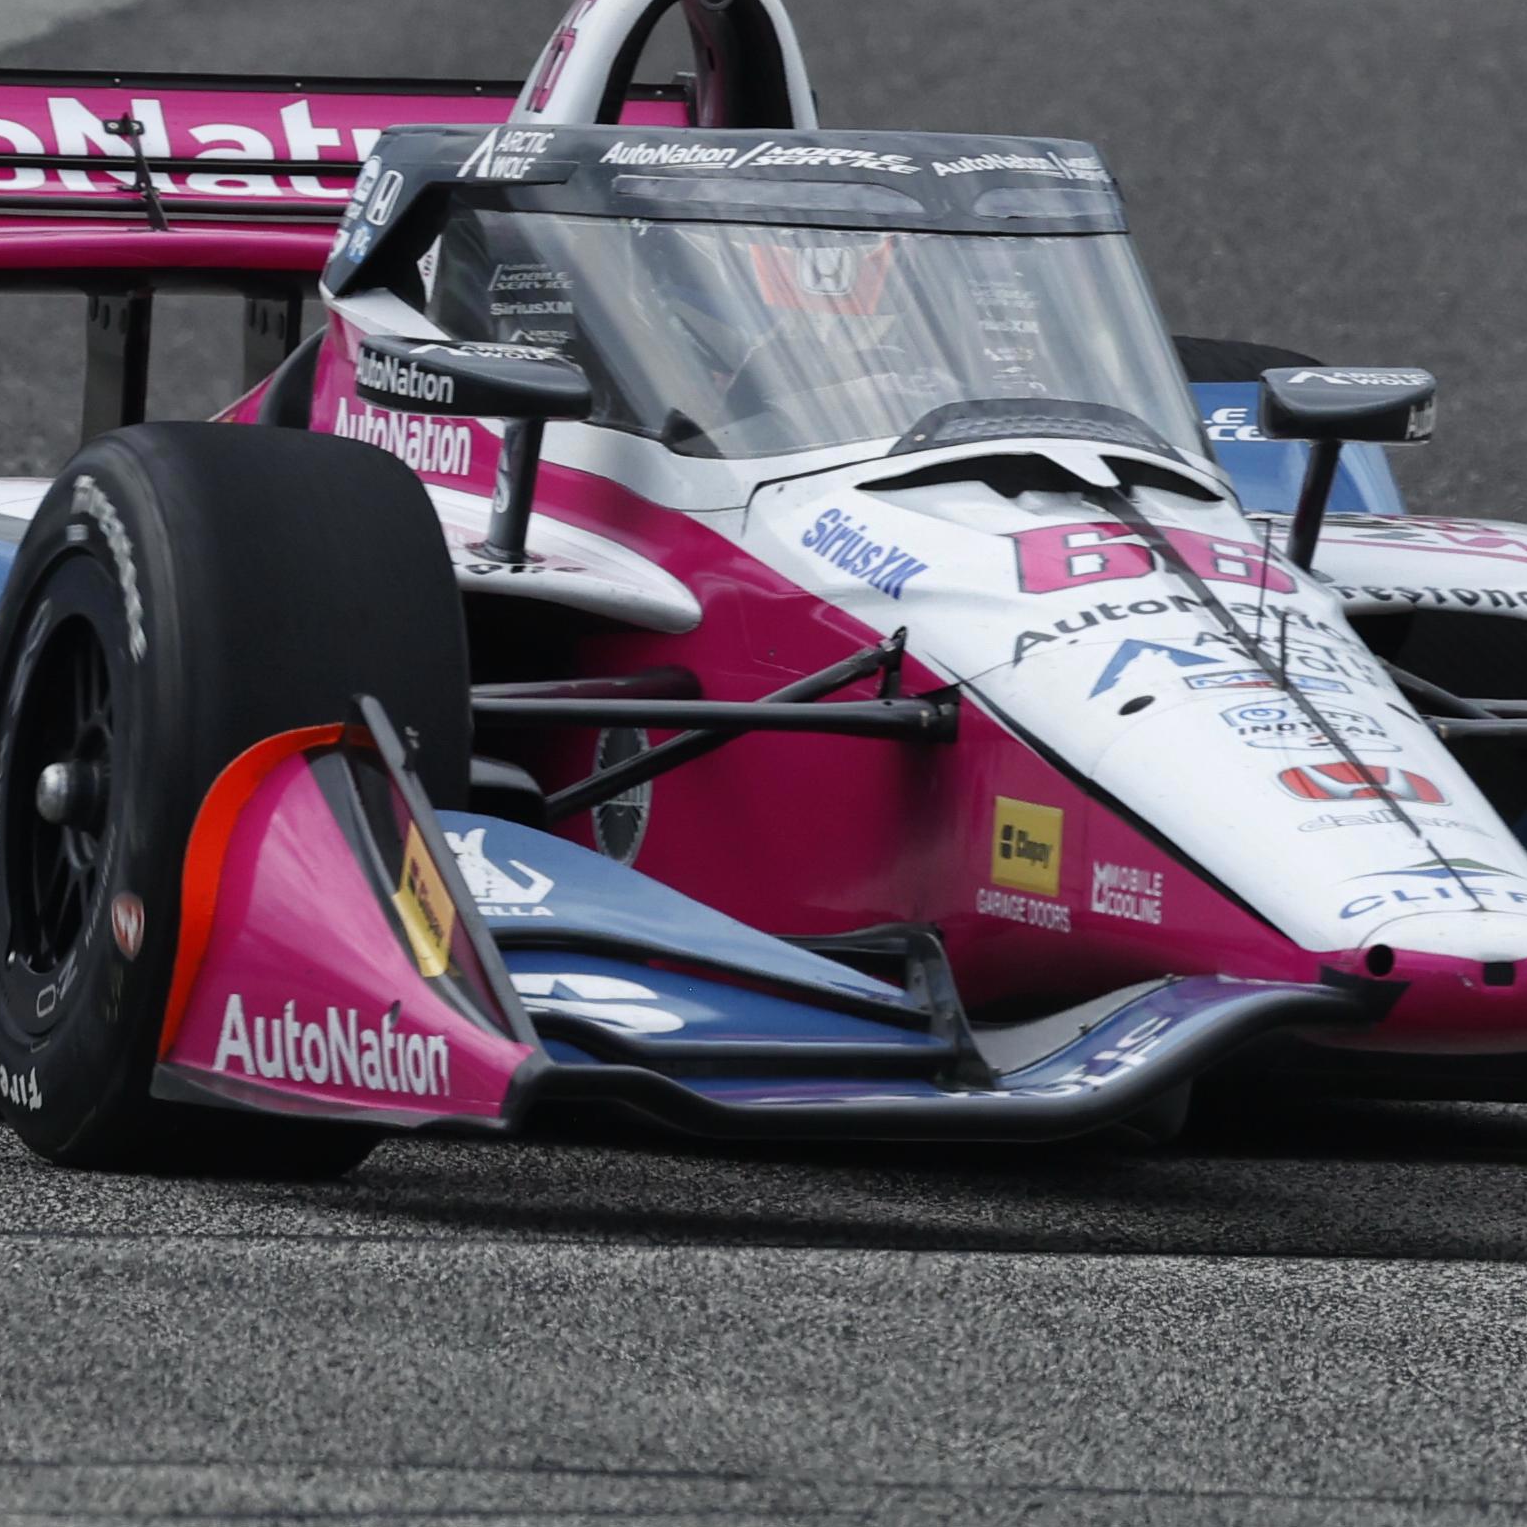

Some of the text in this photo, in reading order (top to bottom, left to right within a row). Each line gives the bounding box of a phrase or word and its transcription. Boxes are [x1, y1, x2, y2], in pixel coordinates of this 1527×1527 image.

[496, 130, 555, 154] ARCTIC
[599, 141, 739, 165] AutoNation
[765, 145, 913, 163] MOBILE
[490, 156, 539, 180] WOLF
[749, 155, 922, 175] SERVICE
[489, 300, 573, 316] SiriusXM
[355, 343, 455, 405] AutoNation
[334, 396, 472, 476] AutoNation
[801, 507, 930, 601] SiriusXM
[1106, 862, 1164, 898] MOBILE
[976, 887, 1073, 934] GARAGE DOORS
[1106, 891, 1163, 925] COOLING
[212, 993, 451, 1097] AutoNation
